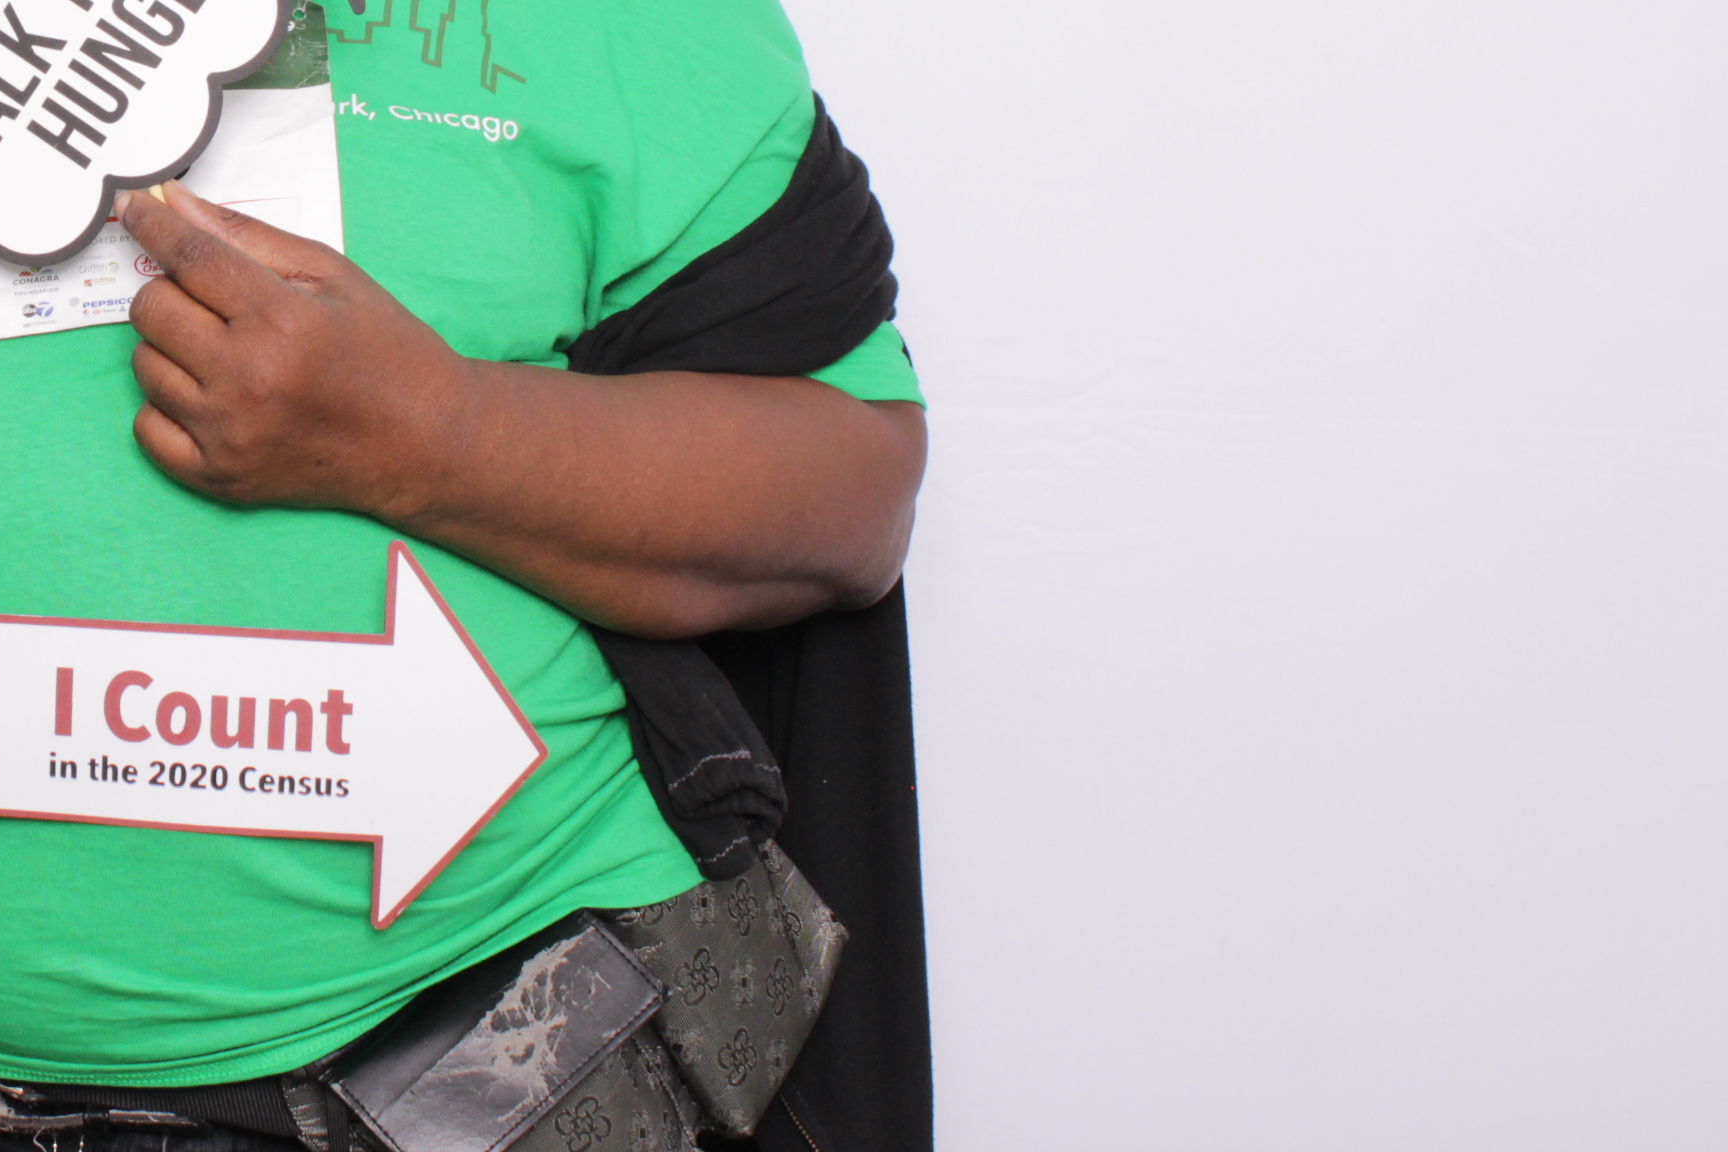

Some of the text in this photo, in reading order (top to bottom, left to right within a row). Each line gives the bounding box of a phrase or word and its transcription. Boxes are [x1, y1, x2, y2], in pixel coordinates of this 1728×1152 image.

[388, 104, 519, 142] Chicago
[13, 275, 60, 286] CONAGRA
[14, 287, 60, 296] FOUNDATION
[54, 666, 353, 755] I Count
[49, 751, 350, 798] in the 2020 Census
